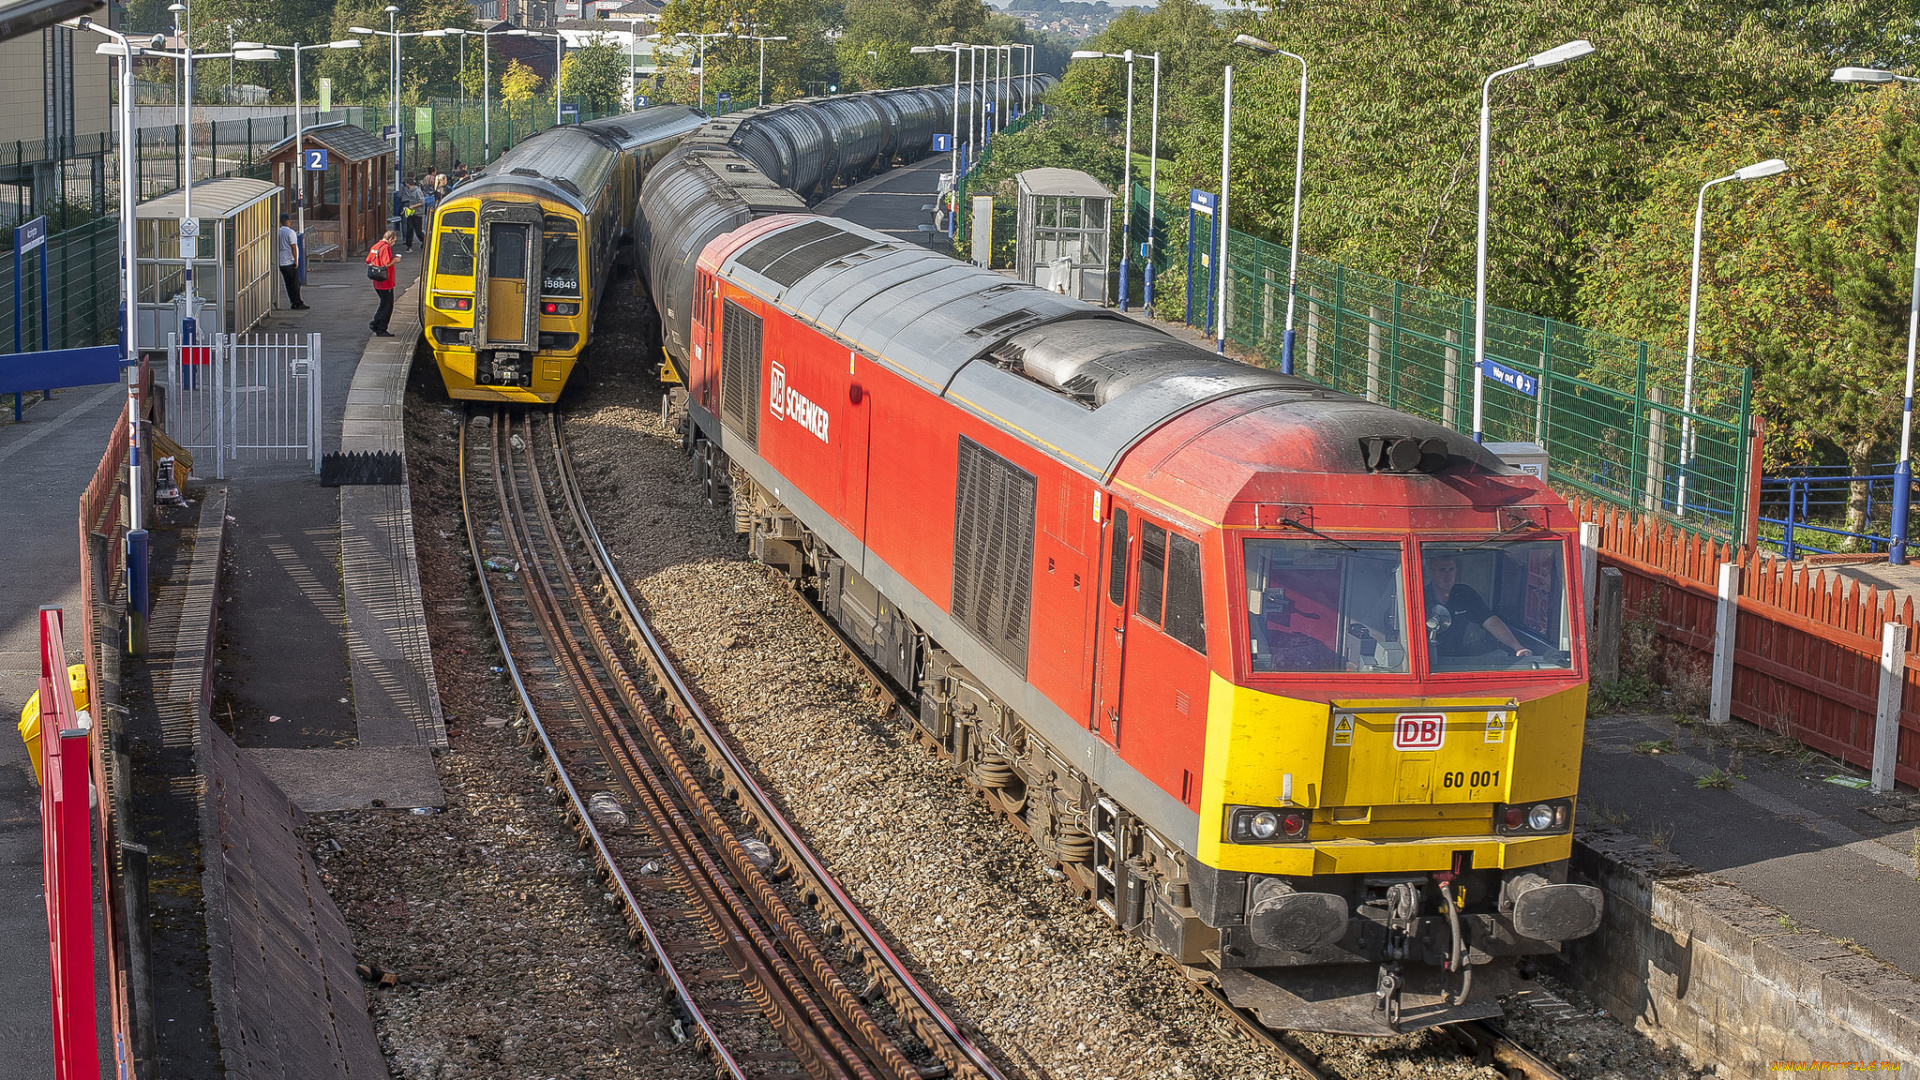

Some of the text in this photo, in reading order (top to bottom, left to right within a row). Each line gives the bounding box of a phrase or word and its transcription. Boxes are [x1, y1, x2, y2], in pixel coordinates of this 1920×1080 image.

[639, 98, 645, 106] 2
[985, 103, 990, 111] 1
[937, 136, 945, 150] 1
[311, 152, 322, 168] 2
[544, 280, 577, 289] 158849
[1492, 366, 1504, 382] Way
[786, 386, 829, 444] SCHENKER
[1402, 721, 1436, 742] DB
[1443, 770, 1500, 788] 60 001
